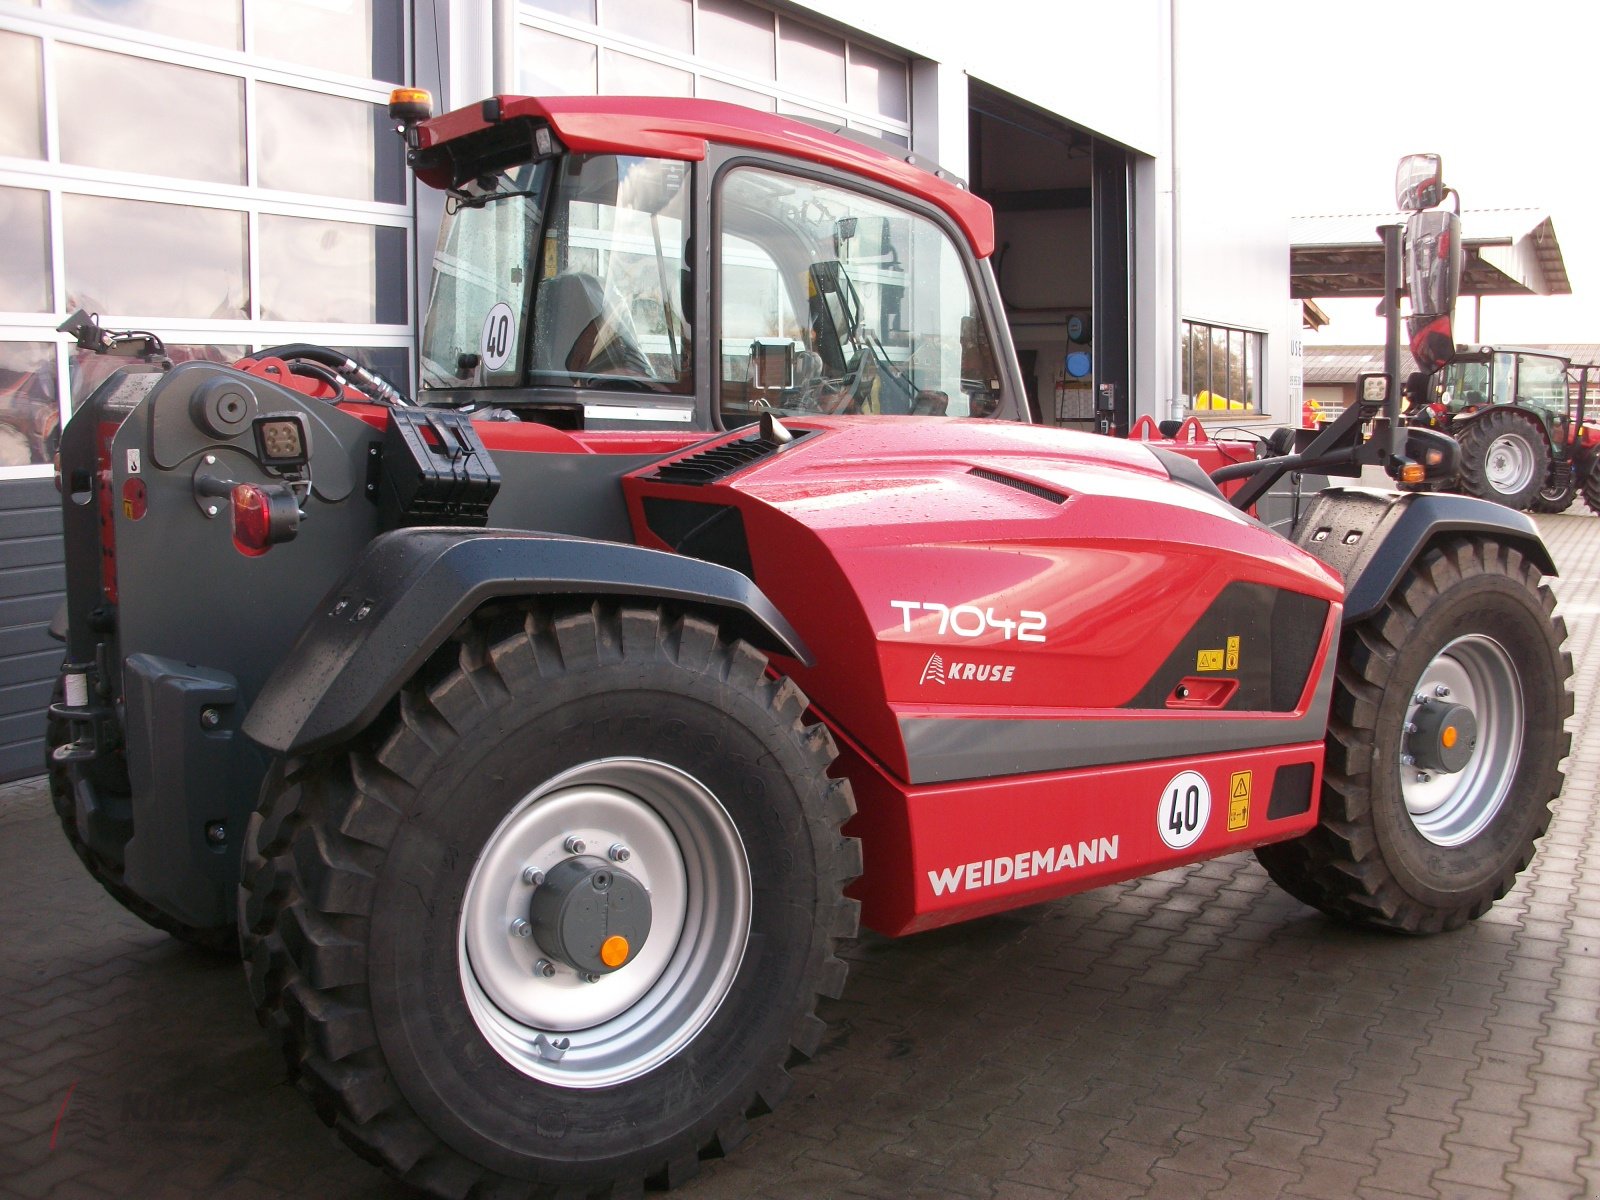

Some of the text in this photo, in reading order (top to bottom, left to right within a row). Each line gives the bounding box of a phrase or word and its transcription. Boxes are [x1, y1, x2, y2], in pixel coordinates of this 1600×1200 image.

[486, 315, 508, 358] 40
[890, 599, 1047, 643] T7042
[947, 661, 1016, 683] KRUSE
[1168, 784, 1199, 835] 40
[927, 834, 1120, 896] WEIDEMANN
